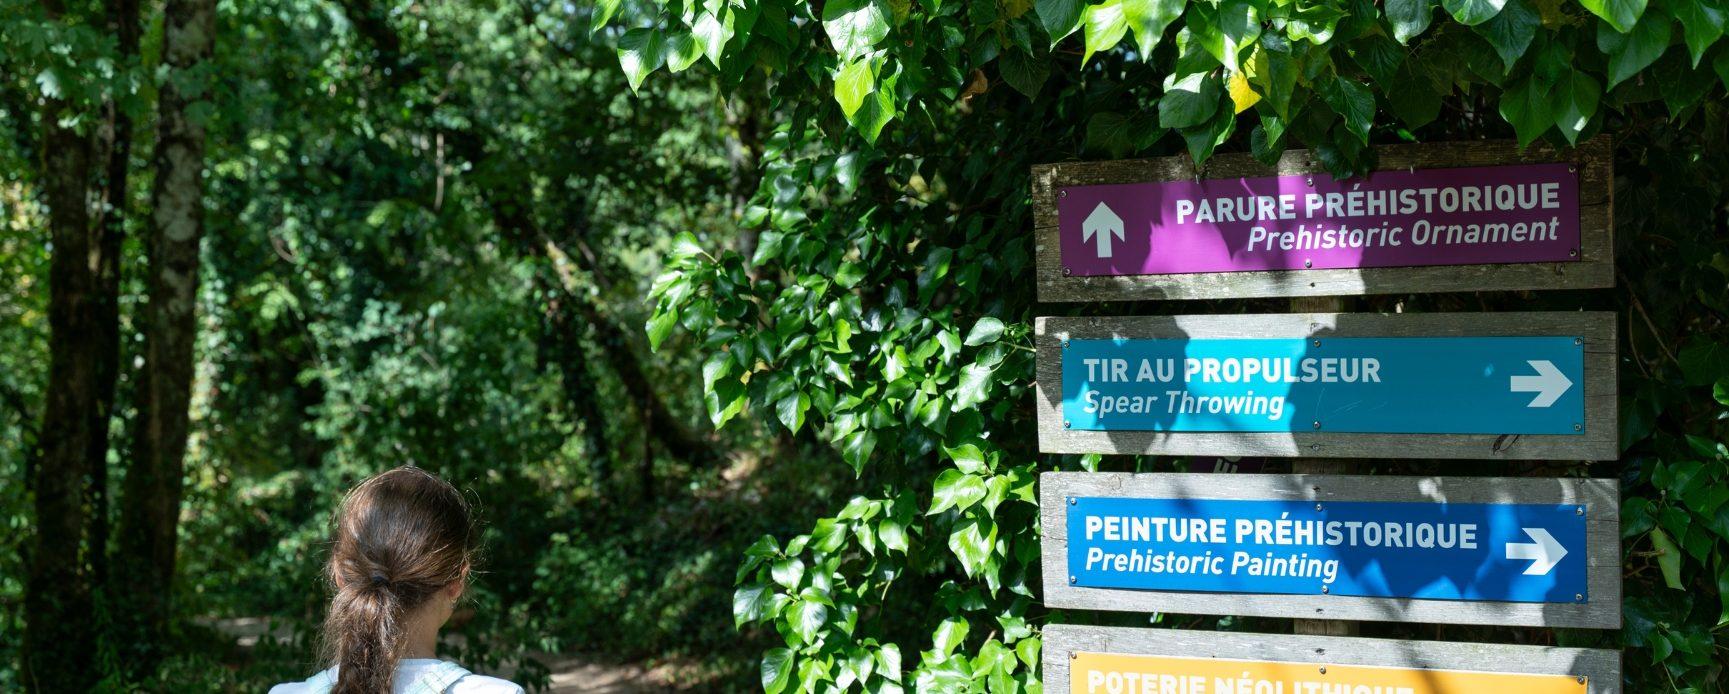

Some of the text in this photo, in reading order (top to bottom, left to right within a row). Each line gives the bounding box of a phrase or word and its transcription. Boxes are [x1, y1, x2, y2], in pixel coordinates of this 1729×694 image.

[1176, 182, 1560, 224] PARURE PRÉHISTORIQUE
[1247, 216, 1560, 252] Prehistoric Ornament
[1083, 357, 1381, 383] TIR AU PROPULSEUR
[1083, 390, 1285, 420] Spear Throwing
[1085, 512, 1478, 549] PEINTURE PRÉHISTORIQUE
[1085, 547, 1339, 584] Prehistoric Painting
[1087, 670, 1206, 694] POTERIE
